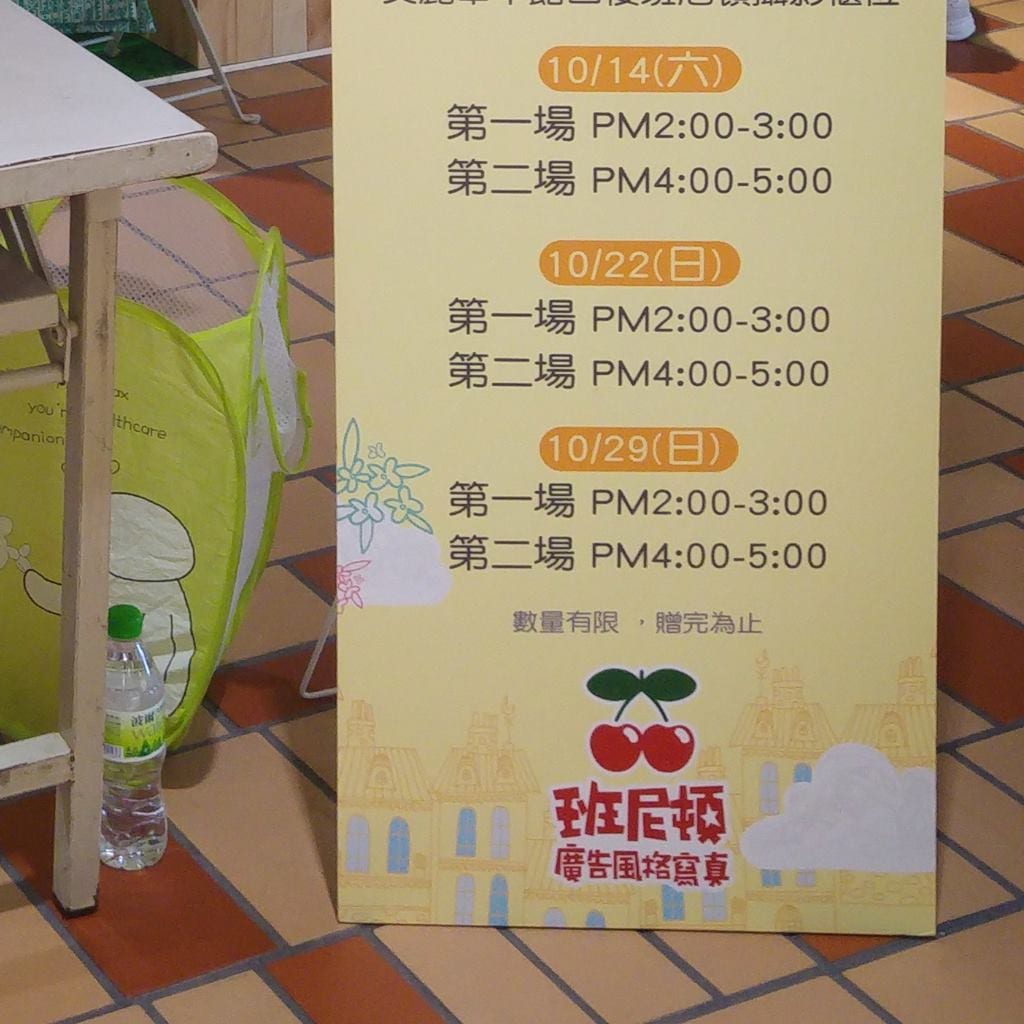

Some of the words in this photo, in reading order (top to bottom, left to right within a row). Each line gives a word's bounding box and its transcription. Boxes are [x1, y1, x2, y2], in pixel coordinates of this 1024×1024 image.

[547, 50, 724, 88] 10/14(六)
[446, 103, 576, 143] 第一場
[592, 111, 833, 140] PM2:00-3:00
[447, 157, 576, 197] 第二場
[592, 166, 832, 195] PM4:00-5:00
[548, 245, 723, 283] 10/22(日)
[448, 296, 576, 336] 第一場
[592, 305, 831, 334] PM2:00-3:00
[448, 351, 576, 390] 第二場
[592, 359, 830, 388] PM4:00-5:00
[27, 401, 67, 418] you'r
[548, 429, 722, 467] 10/29(日)
[448, 480, 576, 519] 第一場
[592, 488, 828, 517] PM2:00-3:00
[448, 534, 576, 572] 第二場
[592, 542, 827, 570] PM4:00-5:00
[553, 780, 726, 845] 班尼頓
[554, 843, 730, 887] 廣告風格寫真
